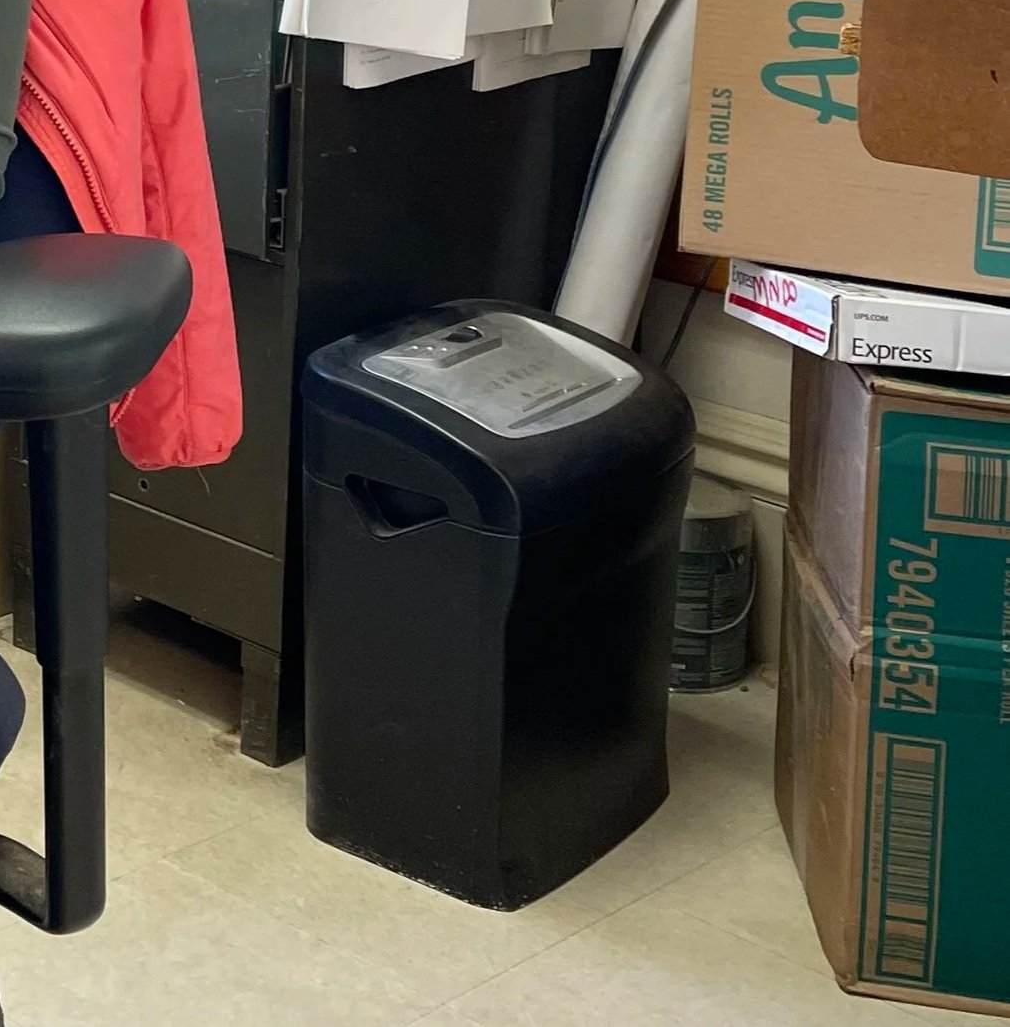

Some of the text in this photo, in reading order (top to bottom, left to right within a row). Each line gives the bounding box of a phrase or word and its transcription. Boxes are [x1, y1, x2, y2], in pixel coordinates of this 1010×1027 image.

[702, 87, 733, 233] 48 MEGA ROLLS
[852, 337, 932, 363] Express
[882, 537, 938, 711] 7940354
